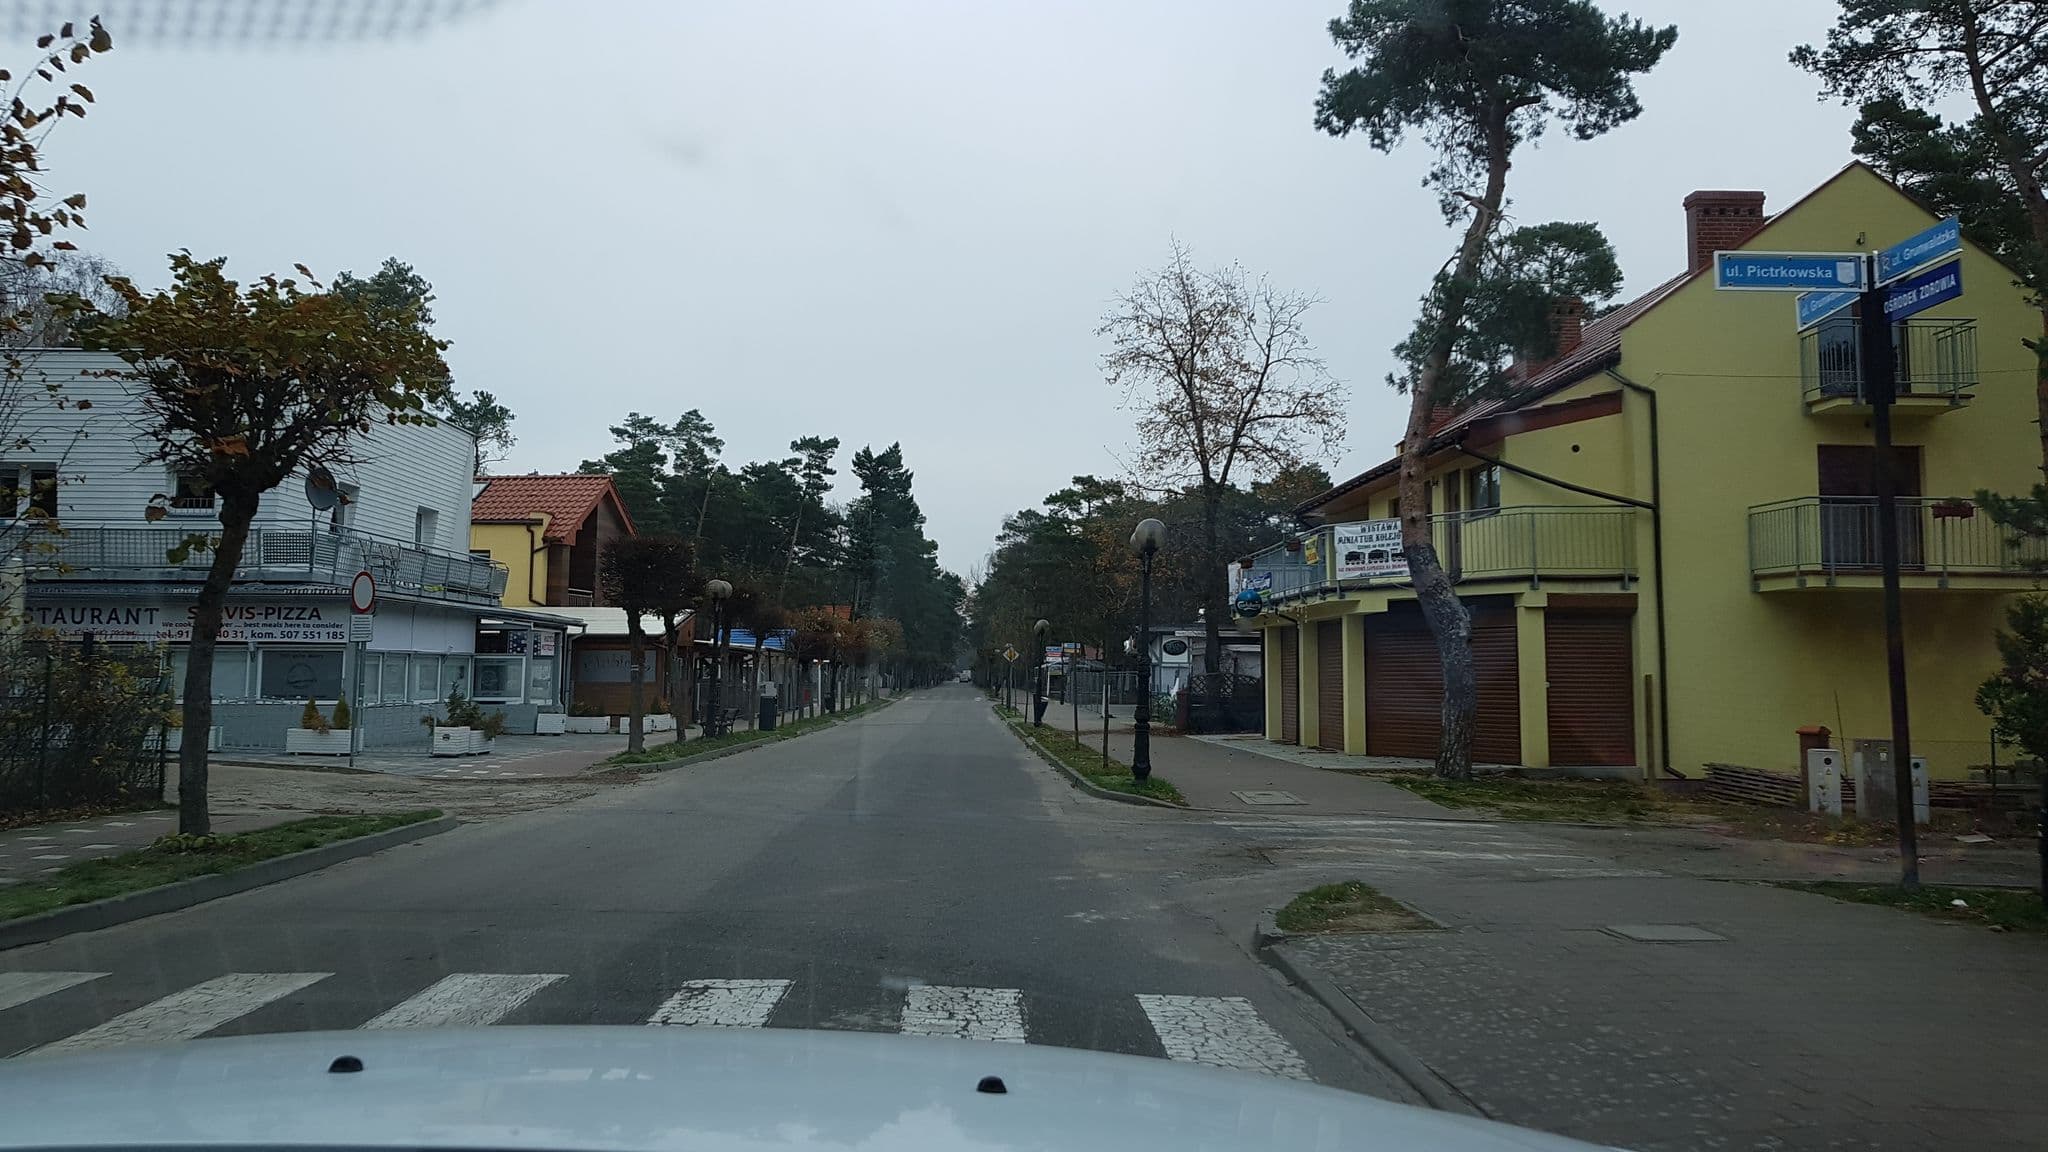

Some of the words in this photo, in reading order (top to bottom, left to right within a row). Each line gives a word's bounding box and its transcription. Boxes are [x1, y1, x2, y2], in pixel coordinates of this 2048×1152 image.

[1725, 265, 1743, 278] ul.
[187, 606, 322, 621] SVIS-PIZZA
[243, 621, 260, 629] best
[262, 621, 283, 629] meals
[284, 621, 301, 629] here
[232, 630, 248, 641] 31,
[250, 630, 277, 639] kom.
[280, 630, 300, 639] 507
[302, 631, 322, 640] 551
[325, 631, 345, 640] 185
